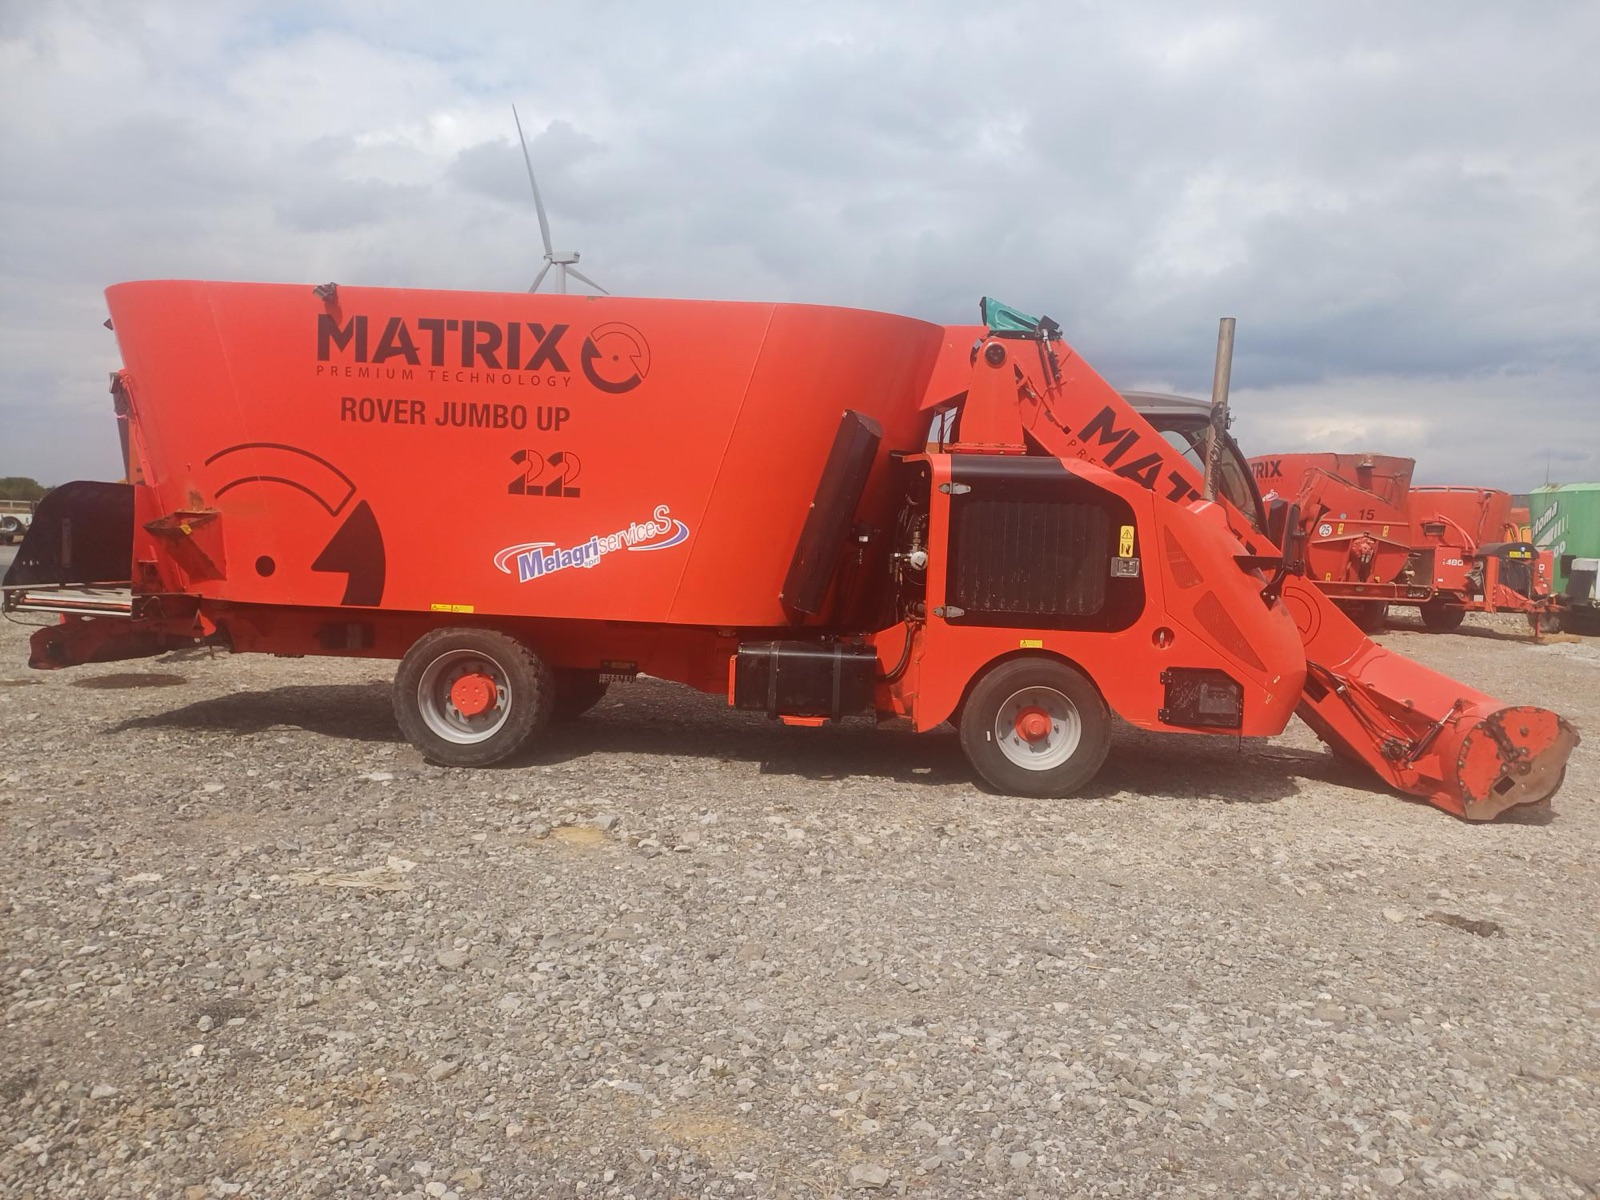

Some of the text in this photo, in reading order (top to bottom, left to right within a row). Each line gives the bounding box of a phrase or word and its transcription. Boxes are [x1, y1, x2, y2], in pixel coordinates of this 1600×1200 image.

[317, 313, 571, 373] MATRIX
[316, 364, 572, 388] PREMIUM TECHNOLOGY
[340, 397, 571, 432] ROVER JUMBO UP
[1066, 439, 1103, 468] PRE
[507, 449, 582, 498] 22
[1359, 509, 1376, 521] 15
[1320, 525, 1331, 536] 25
